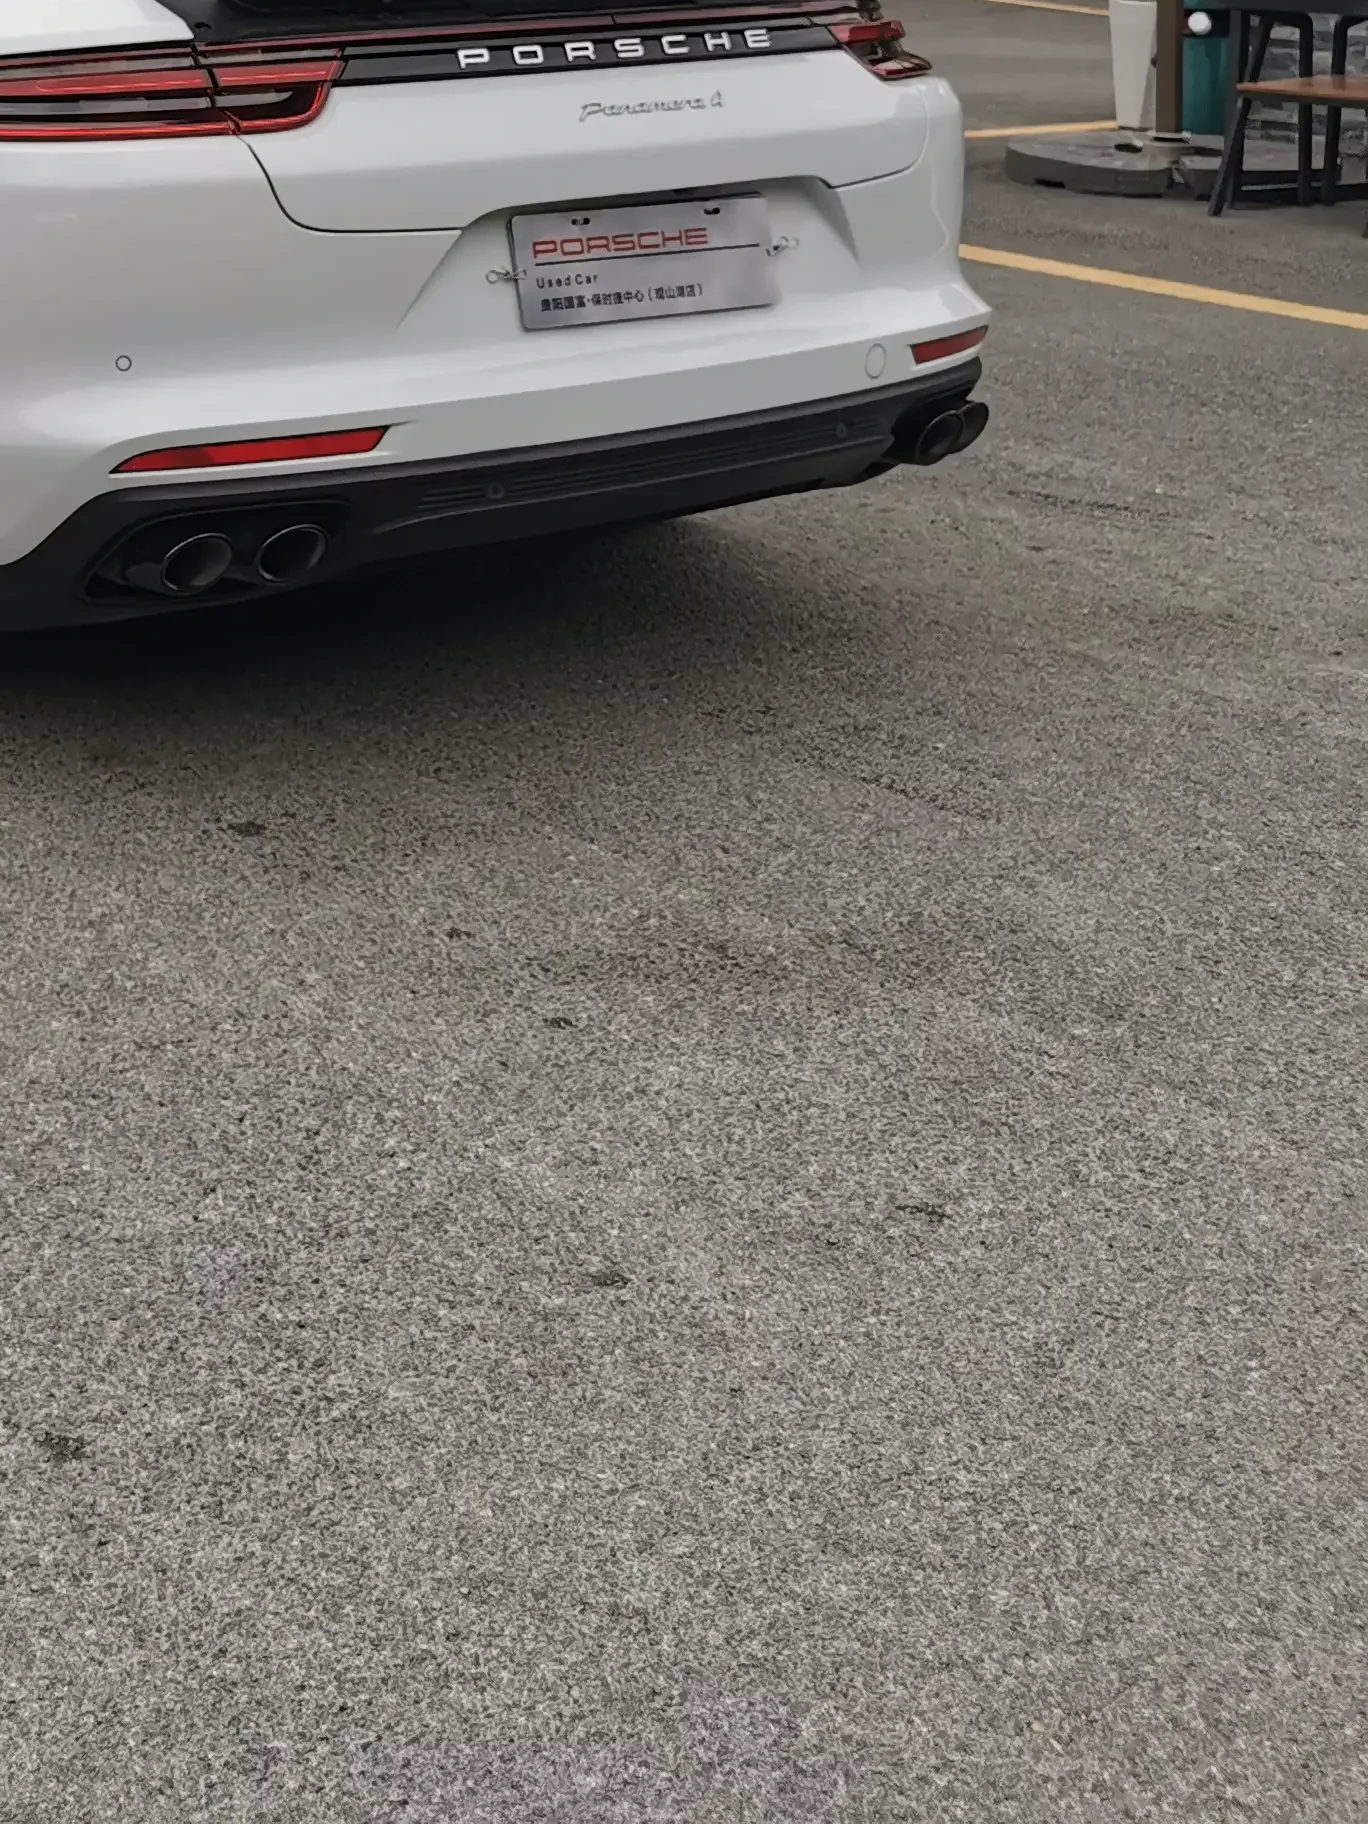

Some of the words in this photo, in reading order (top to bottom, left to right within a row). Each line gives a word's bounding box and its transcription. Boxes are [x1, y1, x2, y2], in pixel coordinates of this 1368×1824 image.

[457, 27, 771, 69] PORSCHE
[578, 97, 706, 122] Panamera
[532, 228, 709, 259] PORSCHE
[536, 273, 571, 289] Used
[575, 273, 599, 285] Car
